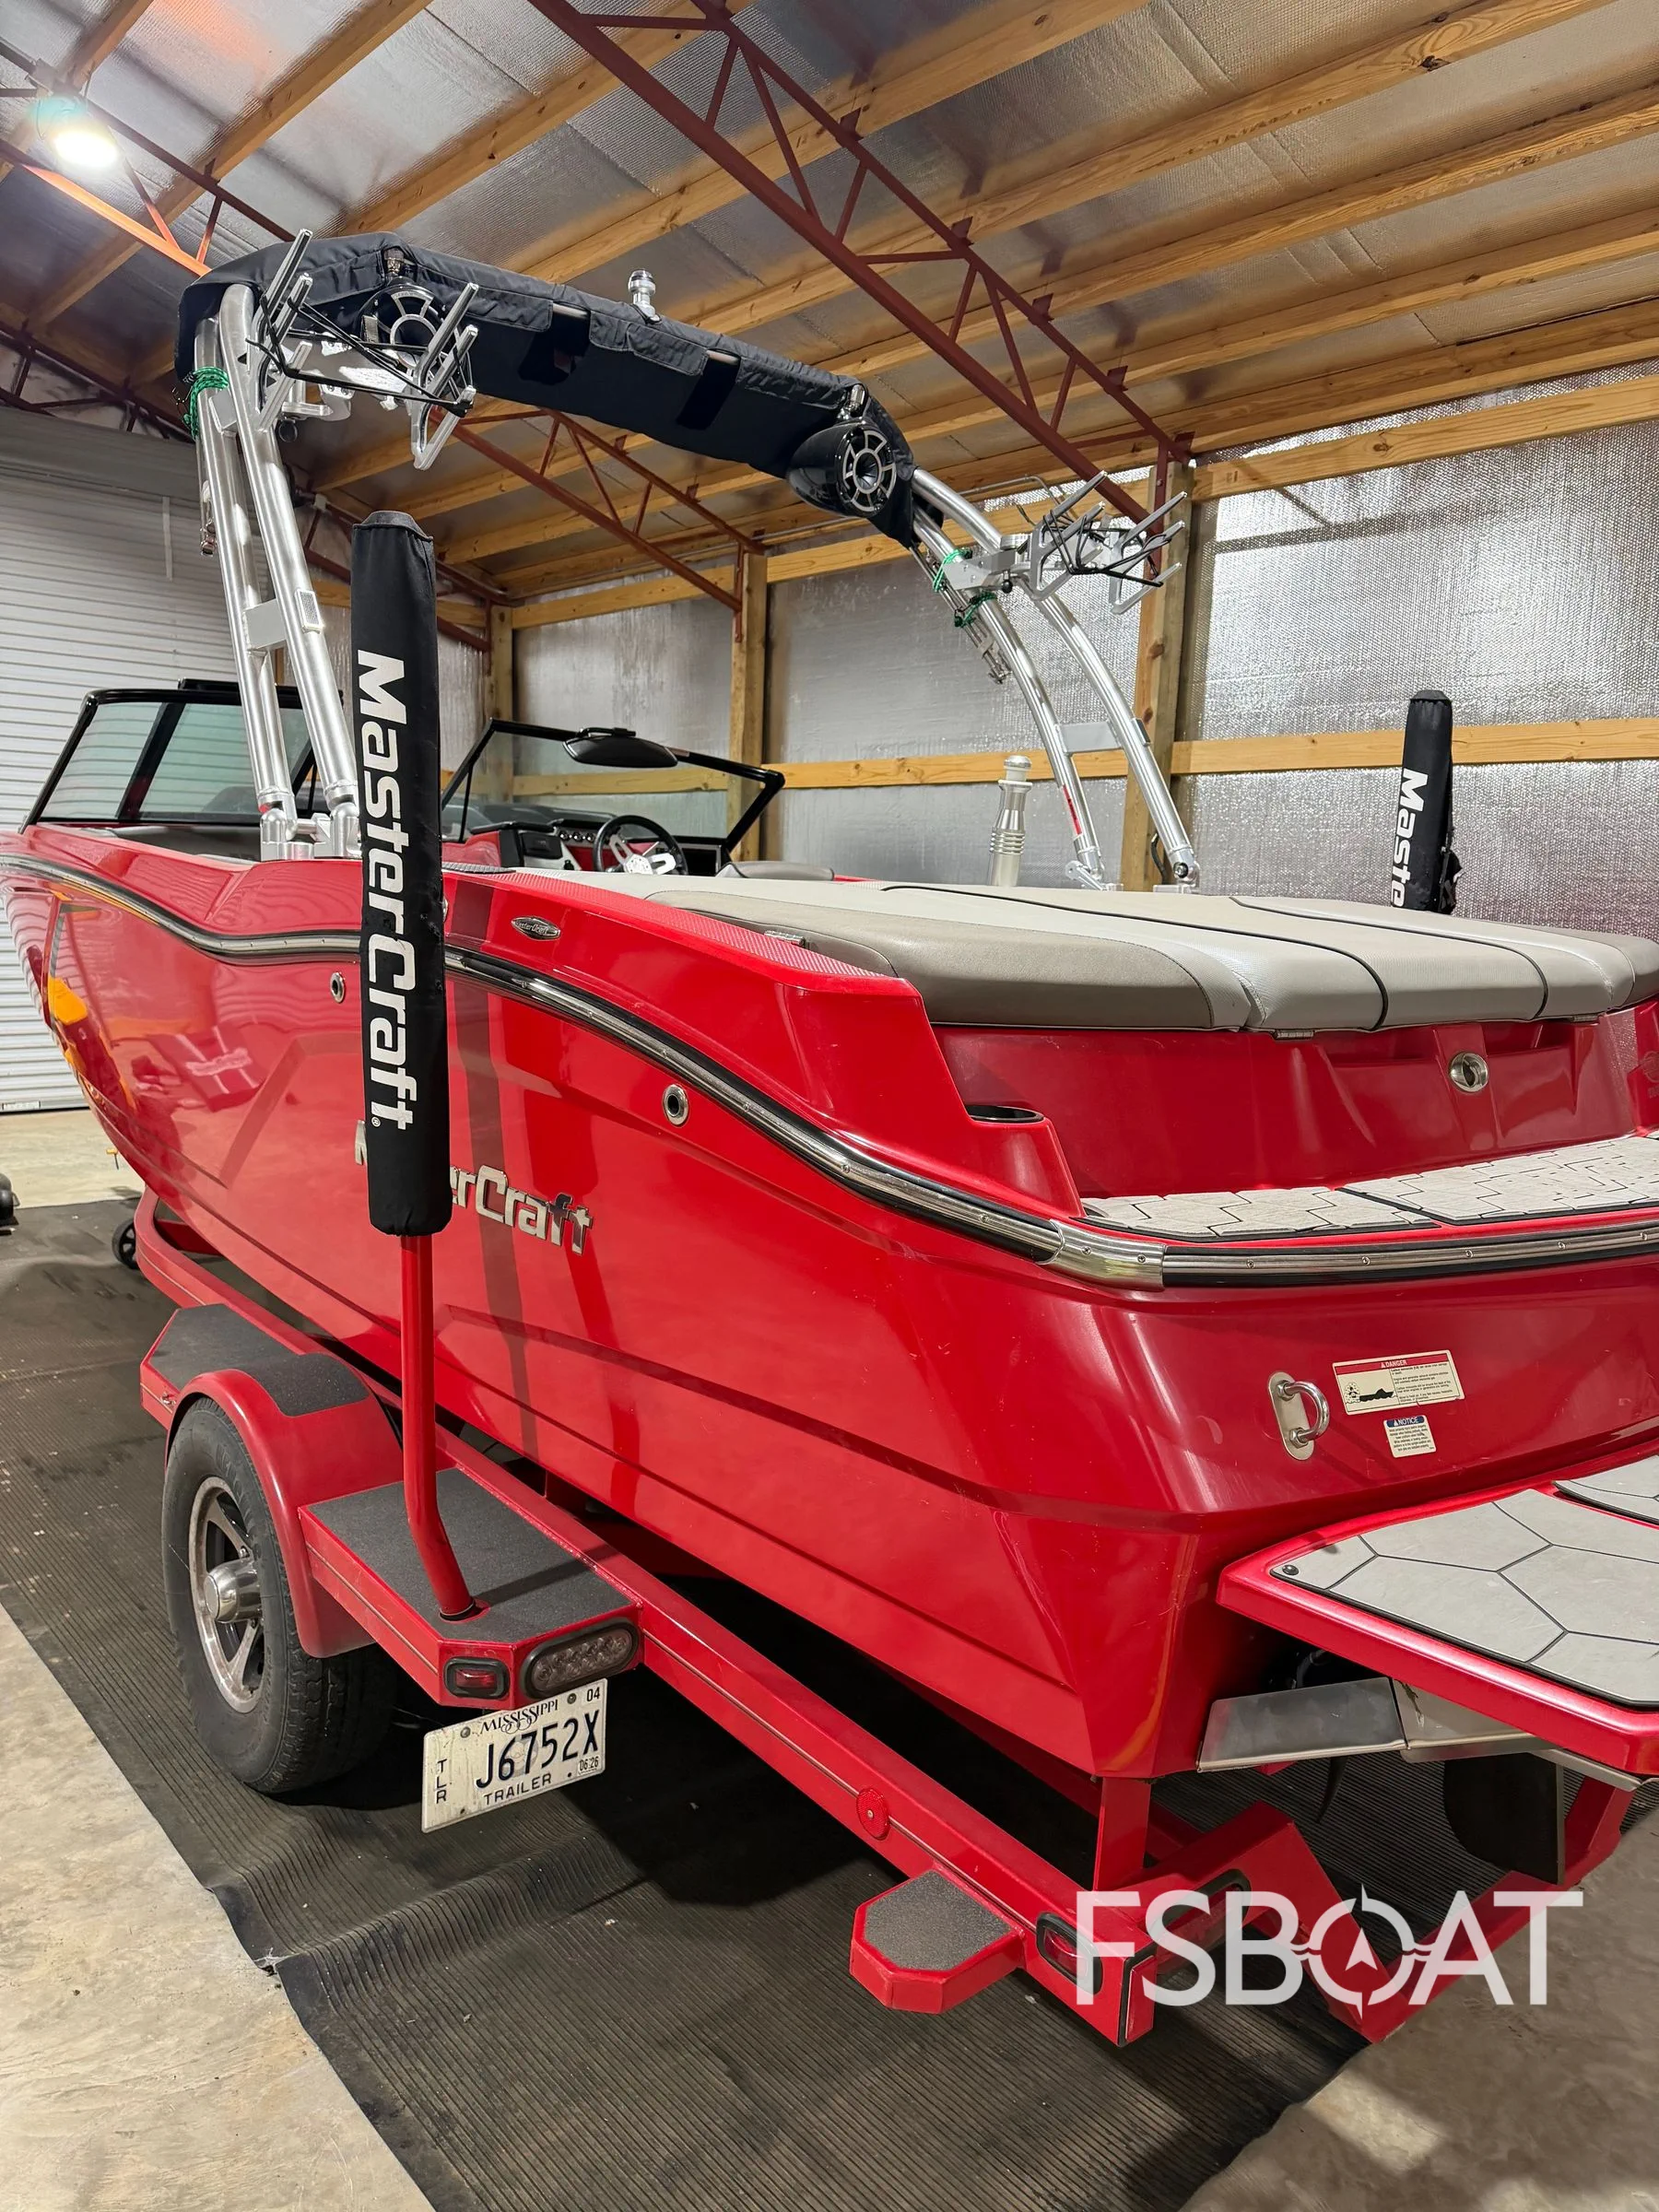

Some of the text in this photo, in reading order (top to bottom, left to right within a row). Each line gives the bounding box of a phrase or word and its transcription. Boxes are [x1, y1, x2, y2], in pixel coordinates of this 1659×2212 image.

[1385, 1359, 1407, 1368] DANGER
[1397, 1417, 1419, 1426] NOTICE
[586, 1687, 601, 1702] 04
[480, 1699, 559, 1734] MISSISSIPPI
[476, 1710, 599, 1789] J6752X
[484, 1773, 551, 1805] TRAILER
